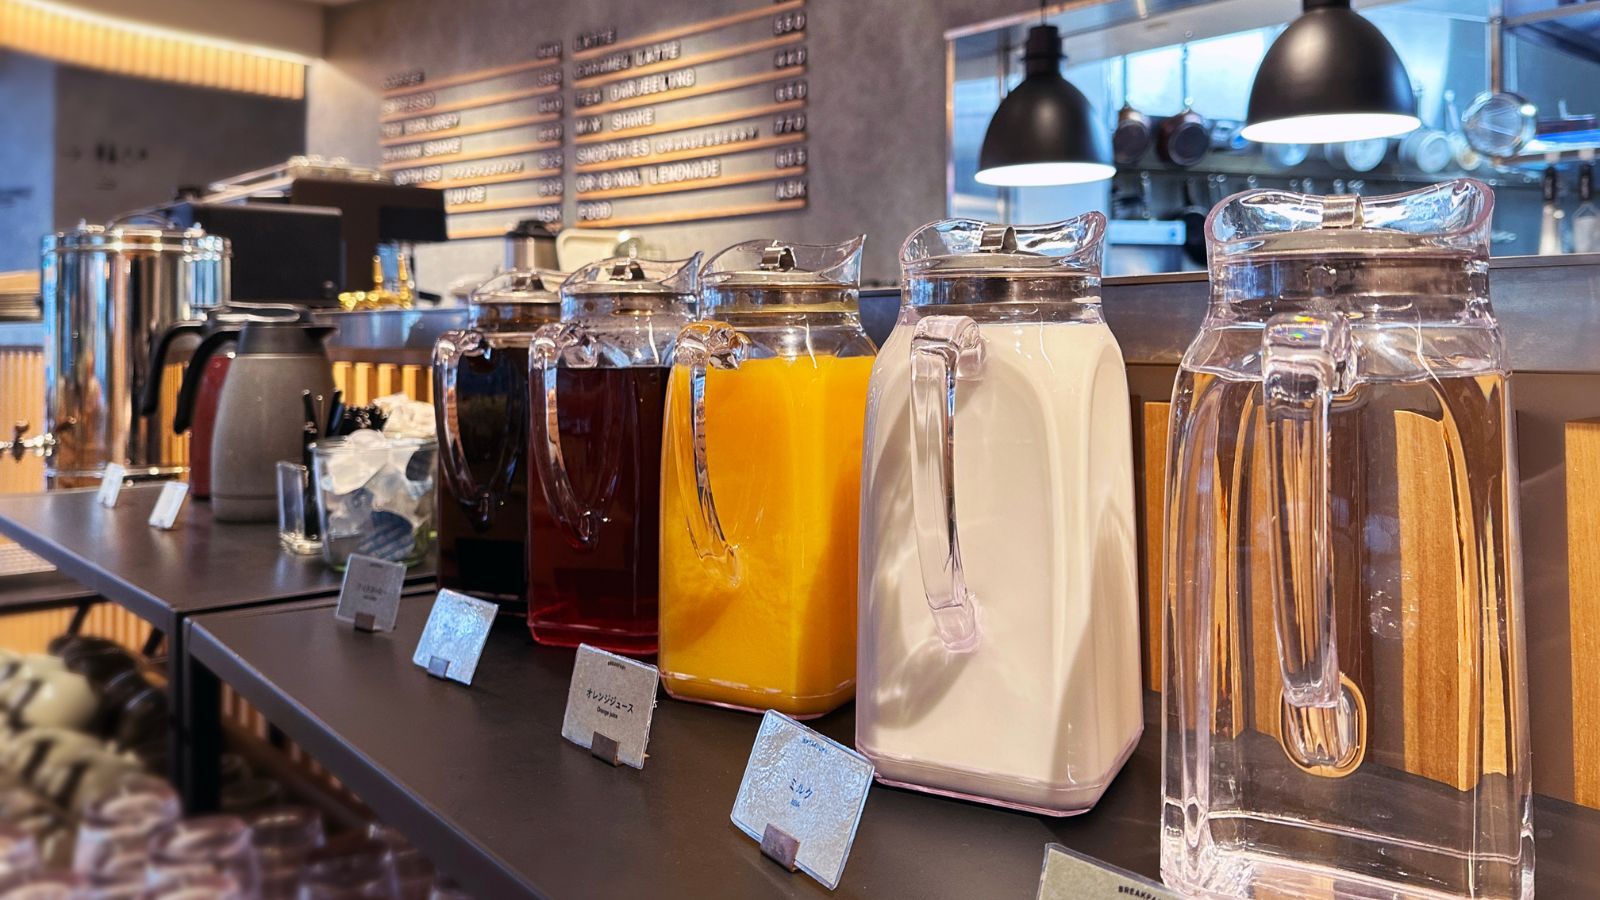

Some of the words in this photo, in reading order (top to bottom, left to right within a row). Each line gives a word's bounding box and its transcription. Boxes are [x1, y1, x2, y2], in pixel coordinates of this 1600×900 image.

[635, 41, 681, 67] LATTE
[611, 68, 696, 101] DARJEELING
[611, 108, 655, 132] SHAKE
[576, 139, 650, 165] SMOOTHIES
[576, 168, 642, 193] ORIGINAL
[649, 159, 721, 185] LEMONADE
[577, 201, 613, 221] FOOD
[586, 688, 634, 714] オレンジジュース
[789, 778, 813, 799] ミルク
